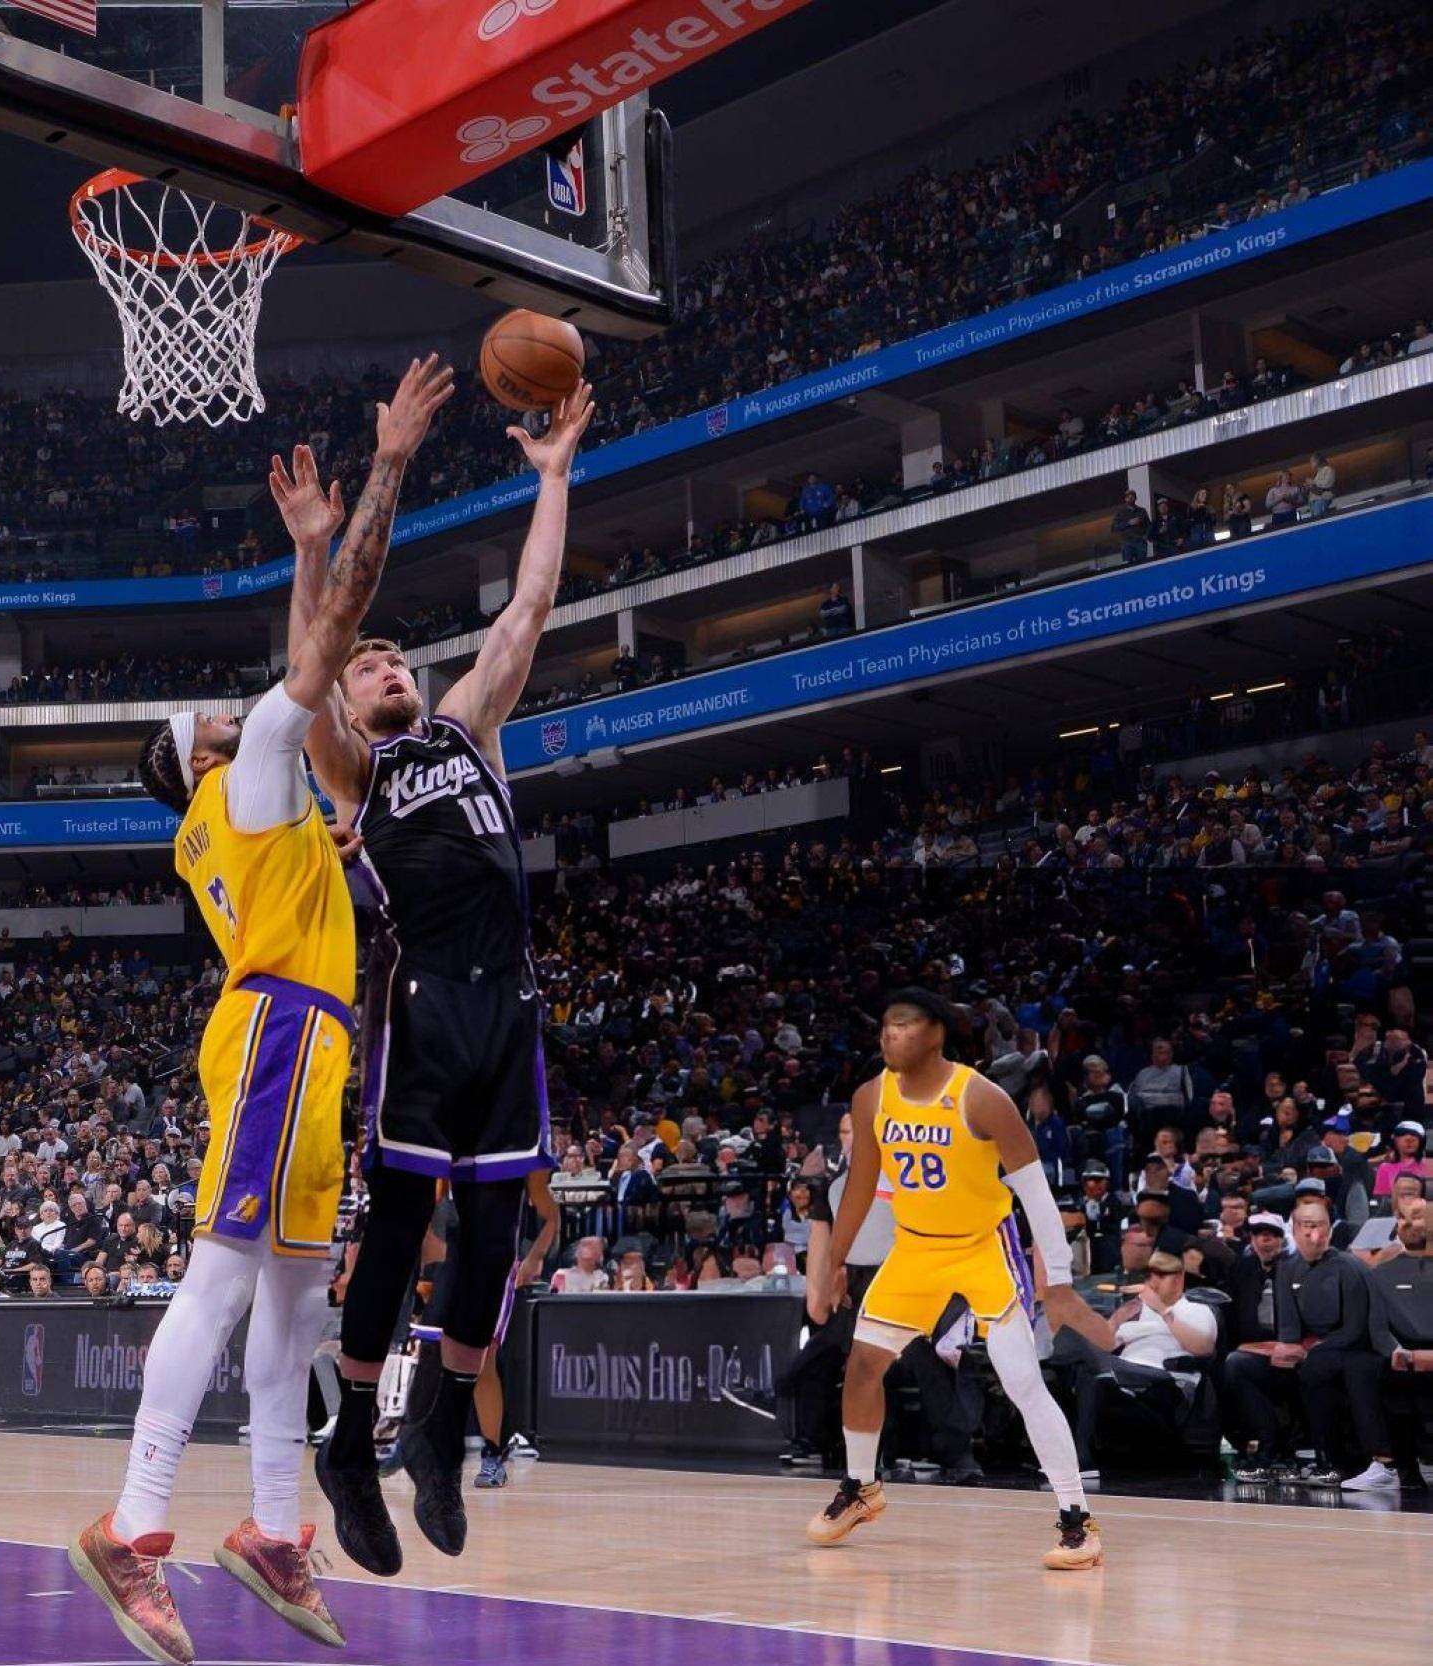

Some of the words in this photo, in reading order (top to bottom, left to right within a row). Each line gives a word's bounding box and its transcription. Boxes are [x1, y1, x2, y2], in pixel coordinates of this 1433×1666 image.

[553, 181, 572, 204] NBA
[916, 335, 965, 363] Trusted
[968, 324, 1006, 345] Team
[1009, 299, 1083, 333] Physicians
[1086, 286, 1104, 305] of
[1106, 281, 1130, 298] the
[1133, 246, 1231, 290] Sacramento
[1236, 226, 1287, 254] Kings
[765, 393, 801, 415] KAISER
[803, 366, 879, 401] PERMANENTE
[491, 484, 540, 507] Sacrame
[42, 590, 76, 604] Kings
[792, 662, 853, 692] Trusted
[857, 653, 904, 676] Team
[909, 631, 1002, 665] Physicians
[1007, 620, 1026, 641] of
[1030, 615, 1062, 637] the
[1067, 584, 1195, 628] Sacramento
[1200, 568, 1266, 597] Kings
[612, 712, 653, 735] KAISER
[658, 688, 748, 721] PERMANENTE
[380, 754, 481, 818] Kings
[64, 817, 118, 833] Trusted
[121, 816, 162, 832] Team
[456, 794, 506, 835] 10
[182, 821, 211, 868] DAVIS
[892, 1151, 947, 1189] 28
[74, 1333, 147, 1390] Noches
